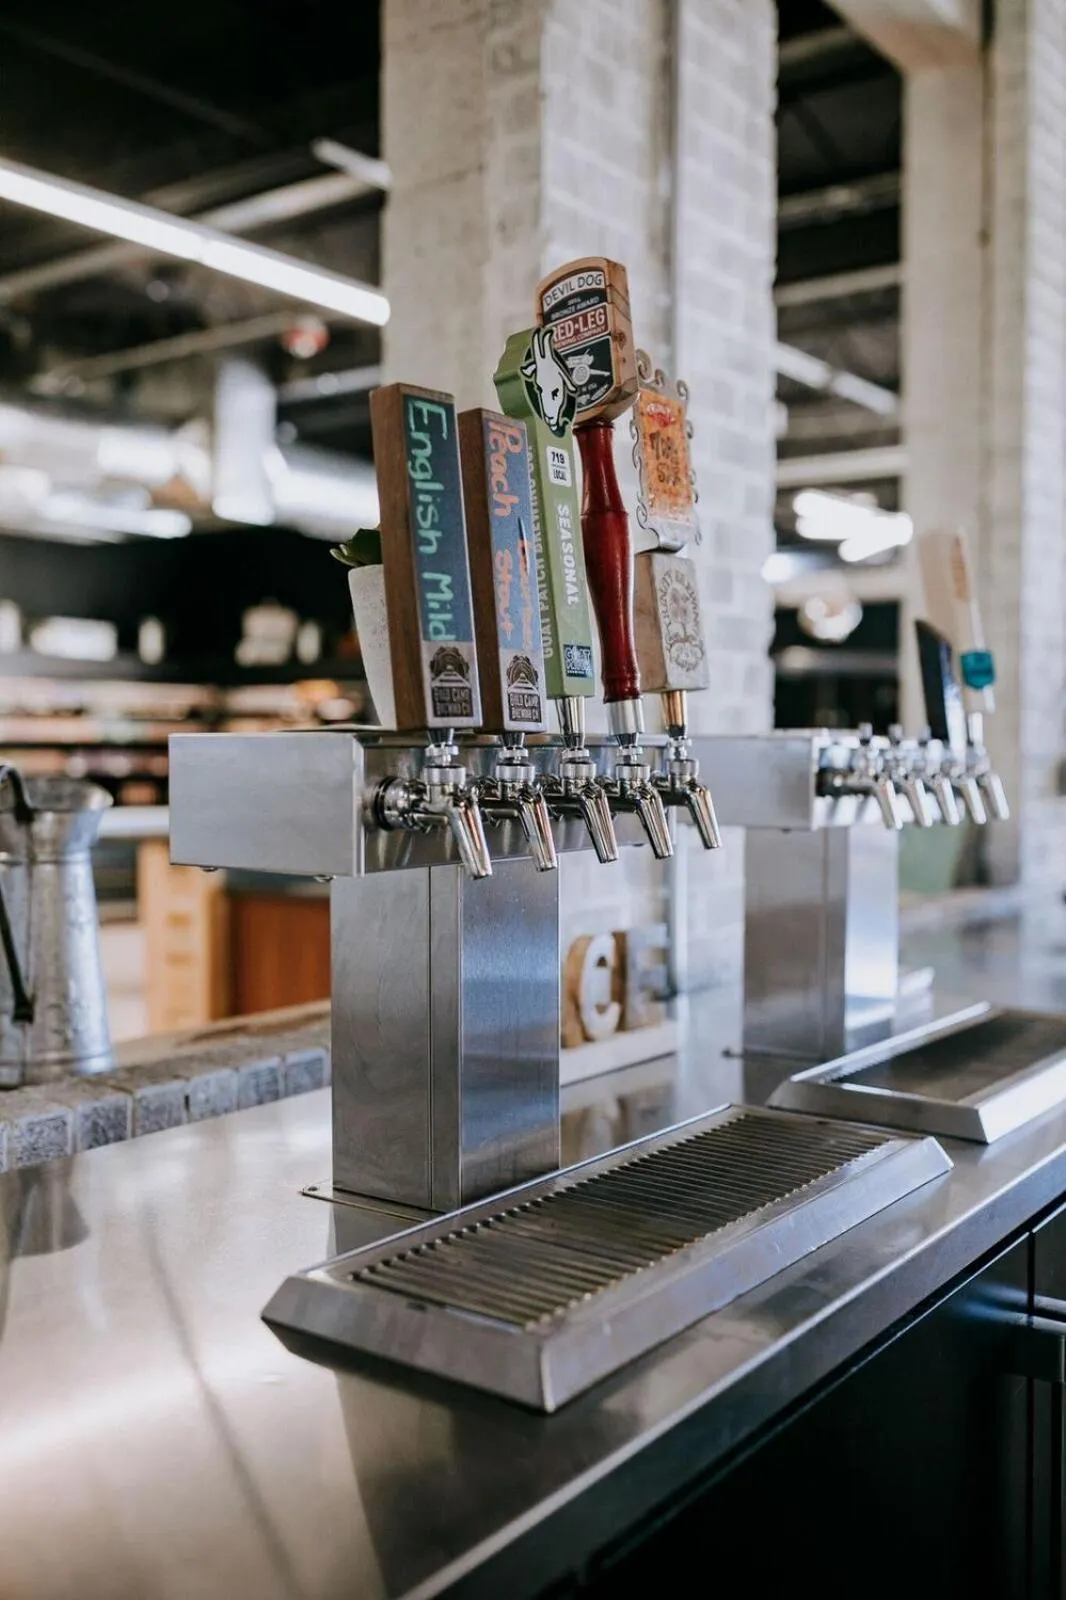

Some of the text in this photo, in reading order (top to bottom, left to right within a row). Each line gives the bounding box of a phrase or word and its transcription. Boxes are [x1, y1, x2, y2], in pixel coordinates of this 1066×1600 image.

[544, 273, 603, 307] DEVIL DOG
[488, 420, 523, 518] Peach
[551, 451, 565, 465] 719
[553, 468, 567, 481] LOCAL
[407, 401, 457, 642] English Mild
[557, 504, 580, 606] SEASONAL
